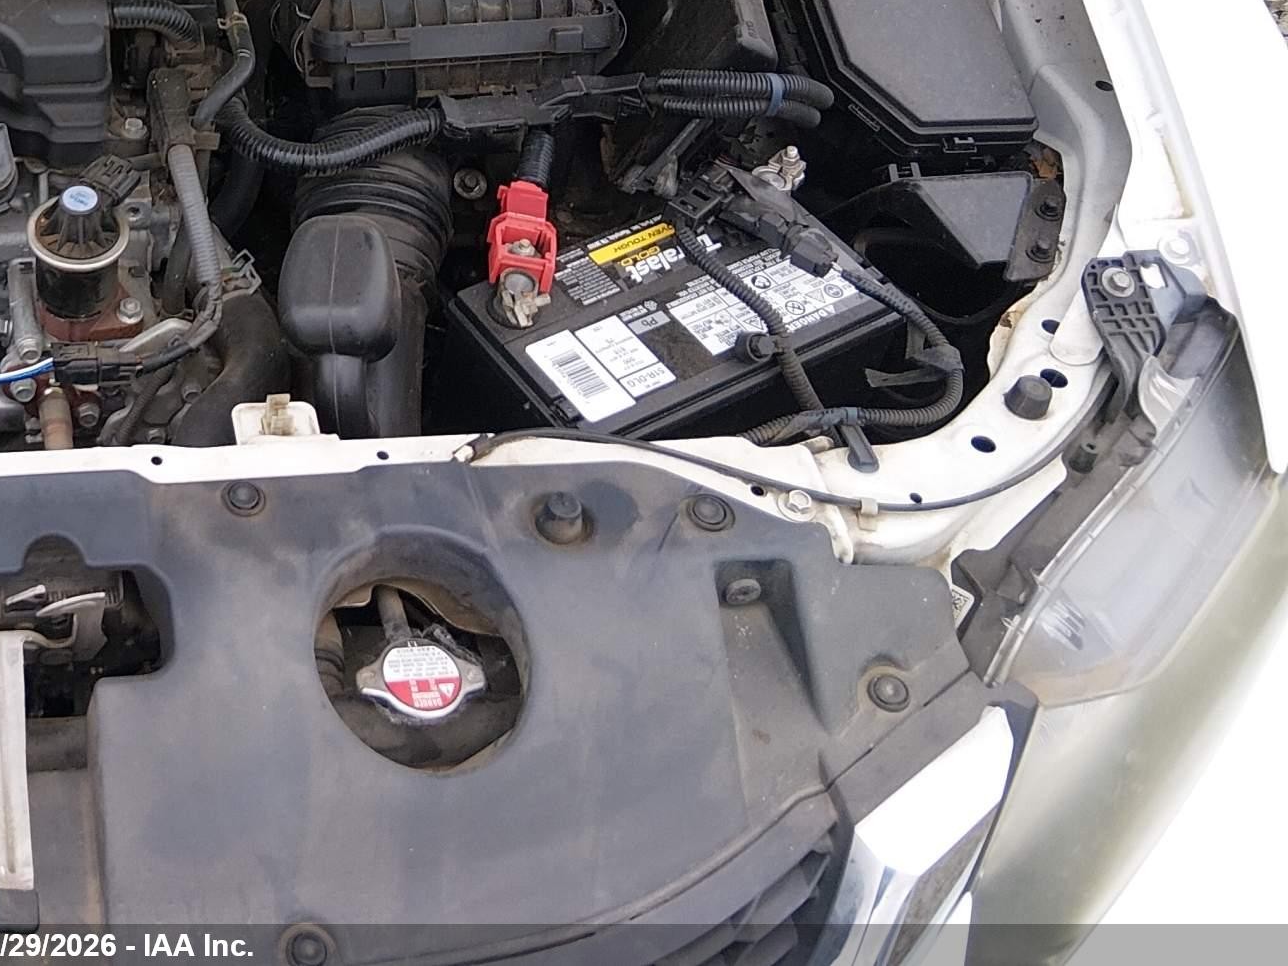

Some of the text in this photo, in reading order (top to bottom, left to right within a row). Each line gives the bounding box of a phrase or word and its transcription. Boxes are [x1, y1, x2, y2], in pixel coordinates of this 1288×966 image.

[614, 234, 649, 252] TOUGH
[620, 245, 660, 267] GOLD
[642, 317, 658, 327] Pb
[785, 310, 829, 333] DANGER
